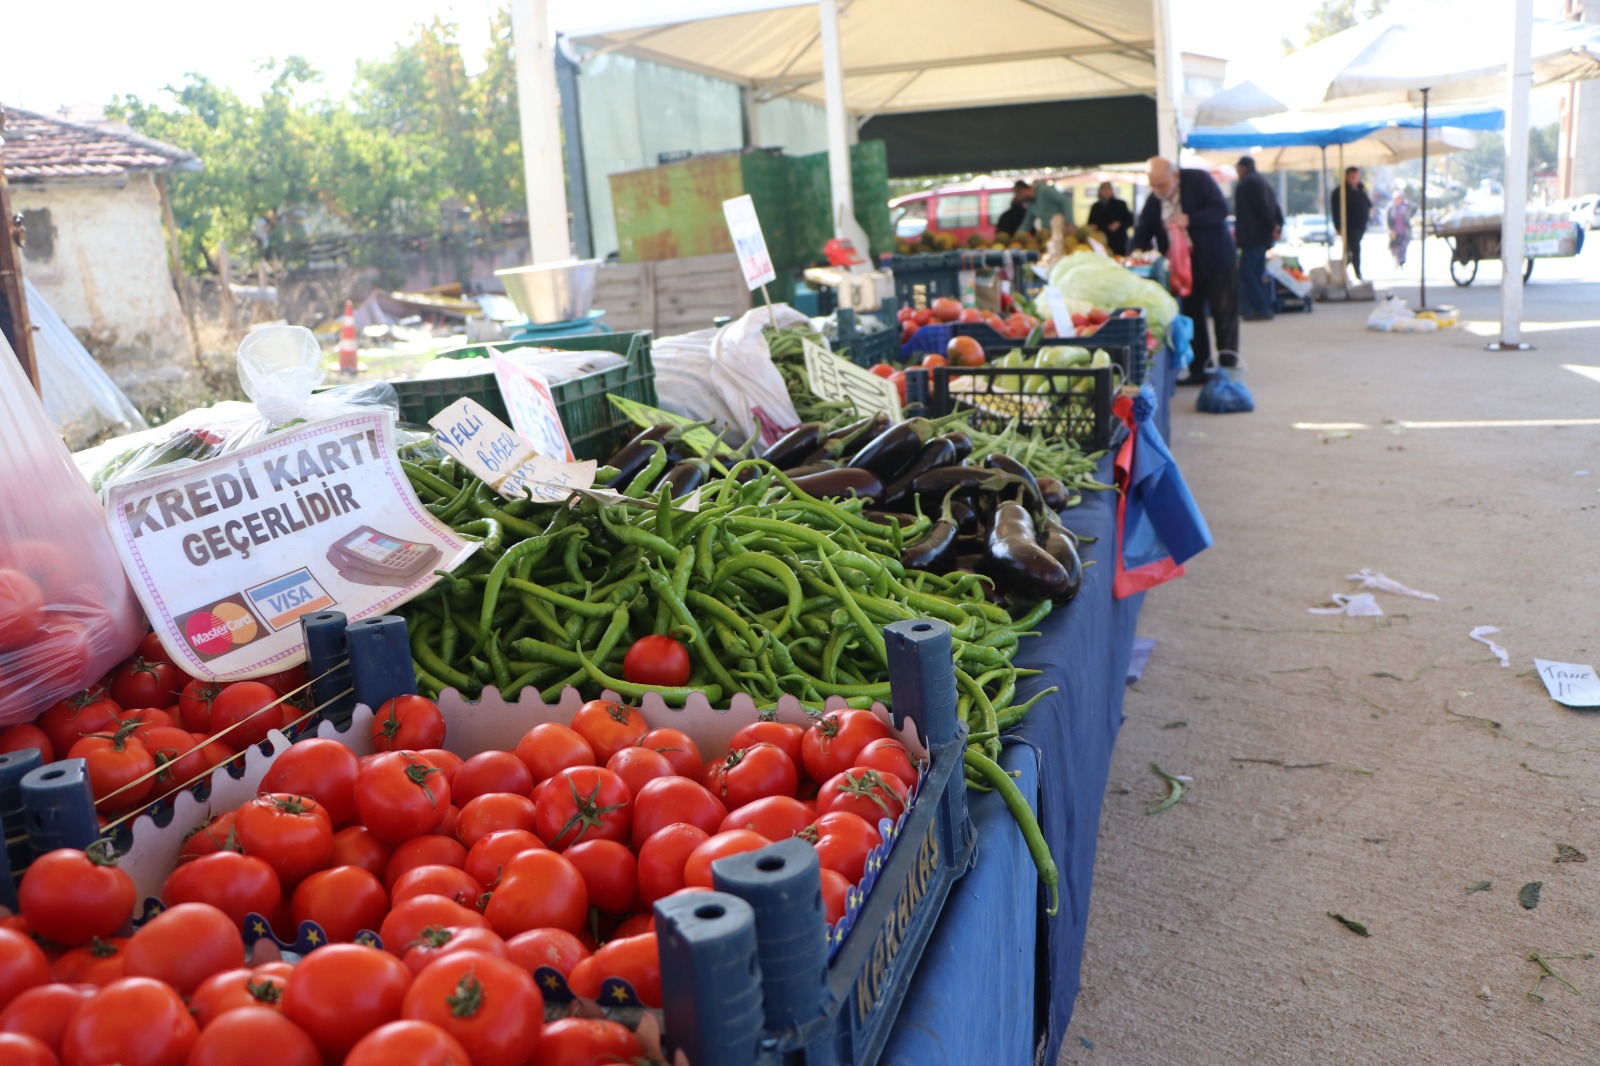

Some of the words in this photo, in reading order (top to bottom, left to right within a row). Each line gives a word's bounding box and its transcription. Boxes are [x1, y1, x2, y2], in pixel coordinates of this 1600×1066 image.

[436, 404, 483, 457] YERLİ
[477, 433, 520, 471] BİBER
[124, 459, 259, 538] KREDİ
[263, 429, 381, 492] KARTI
[182, 481, 361, 566] GEÇERLİDİR
[267, 585, 314, 614] VISA
[191, 614, 254, 647] MasterCard
